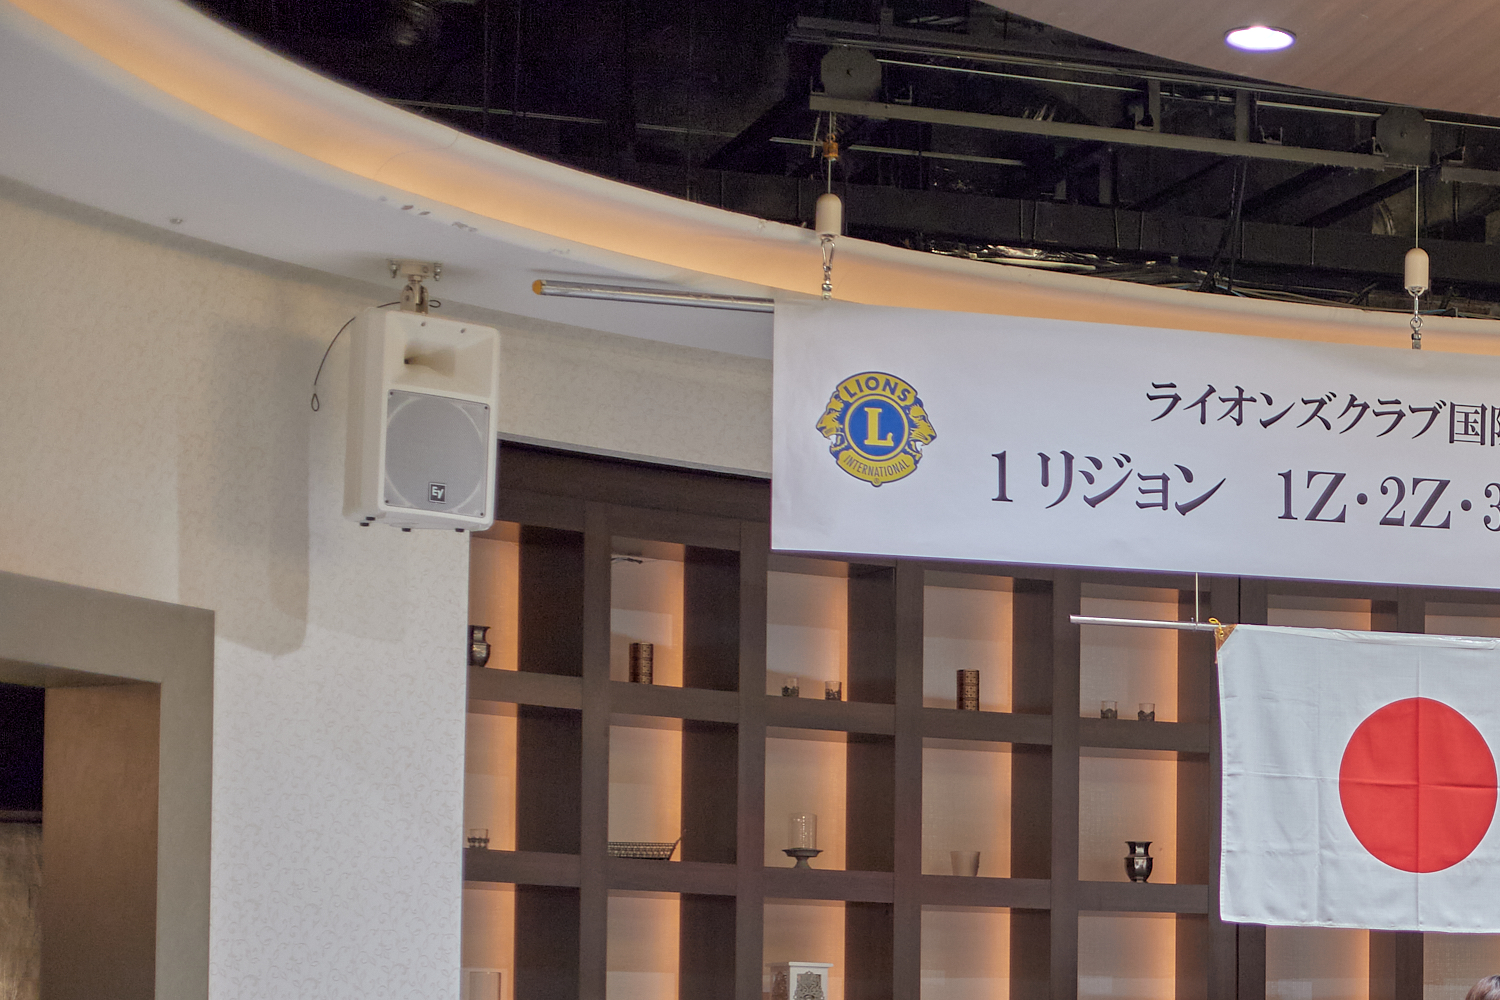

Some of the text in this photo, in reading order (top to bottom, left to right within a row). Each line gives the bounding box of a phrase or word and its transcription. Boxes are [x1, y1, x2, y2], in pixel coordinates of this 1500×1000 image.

[843, 376, 911, 402] LIONS
[863, 407, 894, 447] L
[843, 455, 911, 477] INTERNATIONAL
